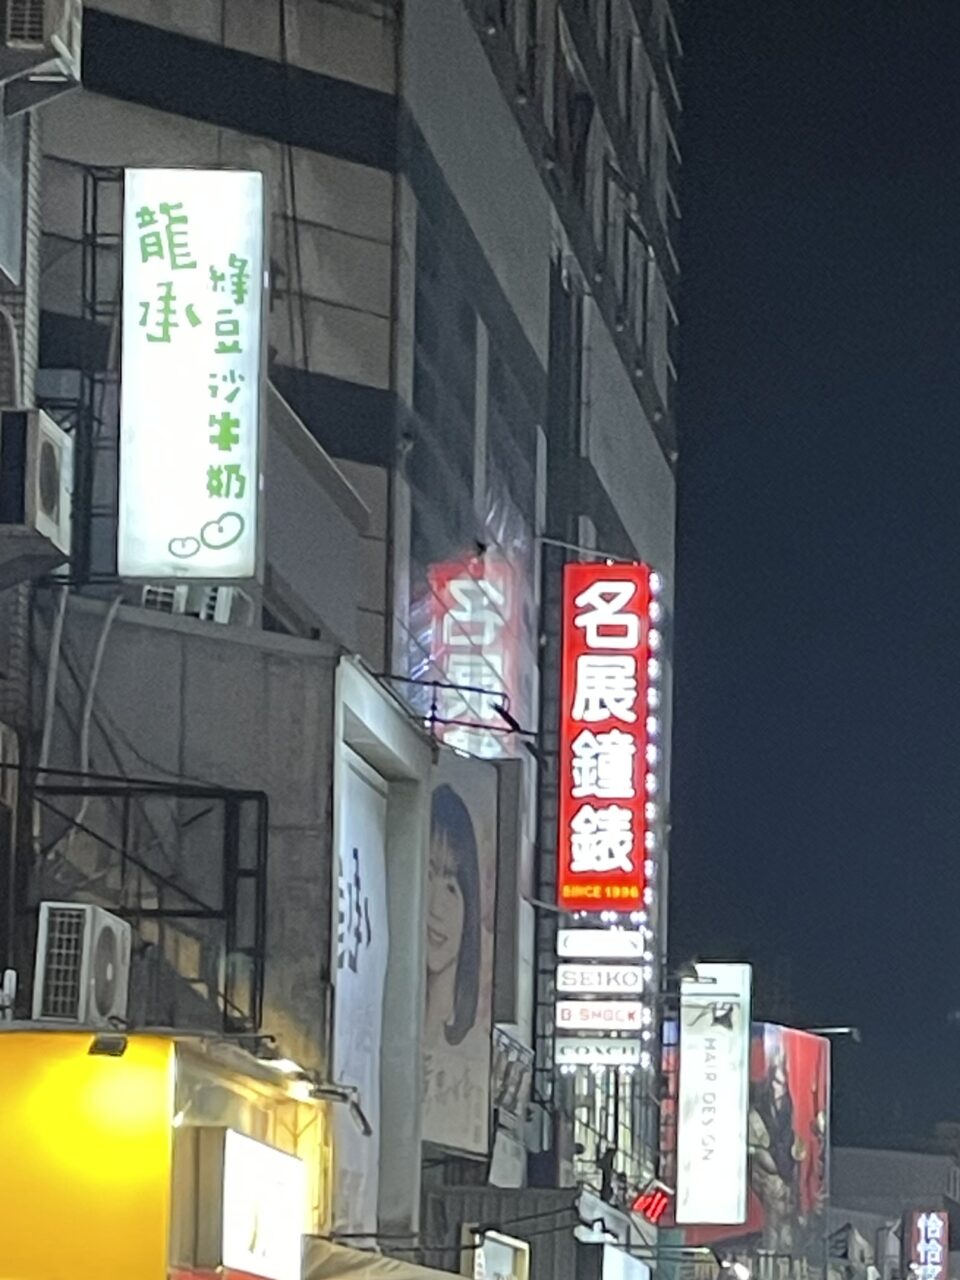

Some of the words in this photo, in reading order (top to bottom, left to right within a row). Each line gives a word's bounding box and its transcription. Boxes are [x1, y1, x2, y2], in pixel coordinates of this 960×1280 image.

[570, 580, 641, 873] 名展鐘錶
[562, 884, 602, 898] SINCE
[561, 971, 639, 987] SEIKO
[703, 1037, 717, 1082] HAIR
[701, 1092, 717, 1161] DESIGN
